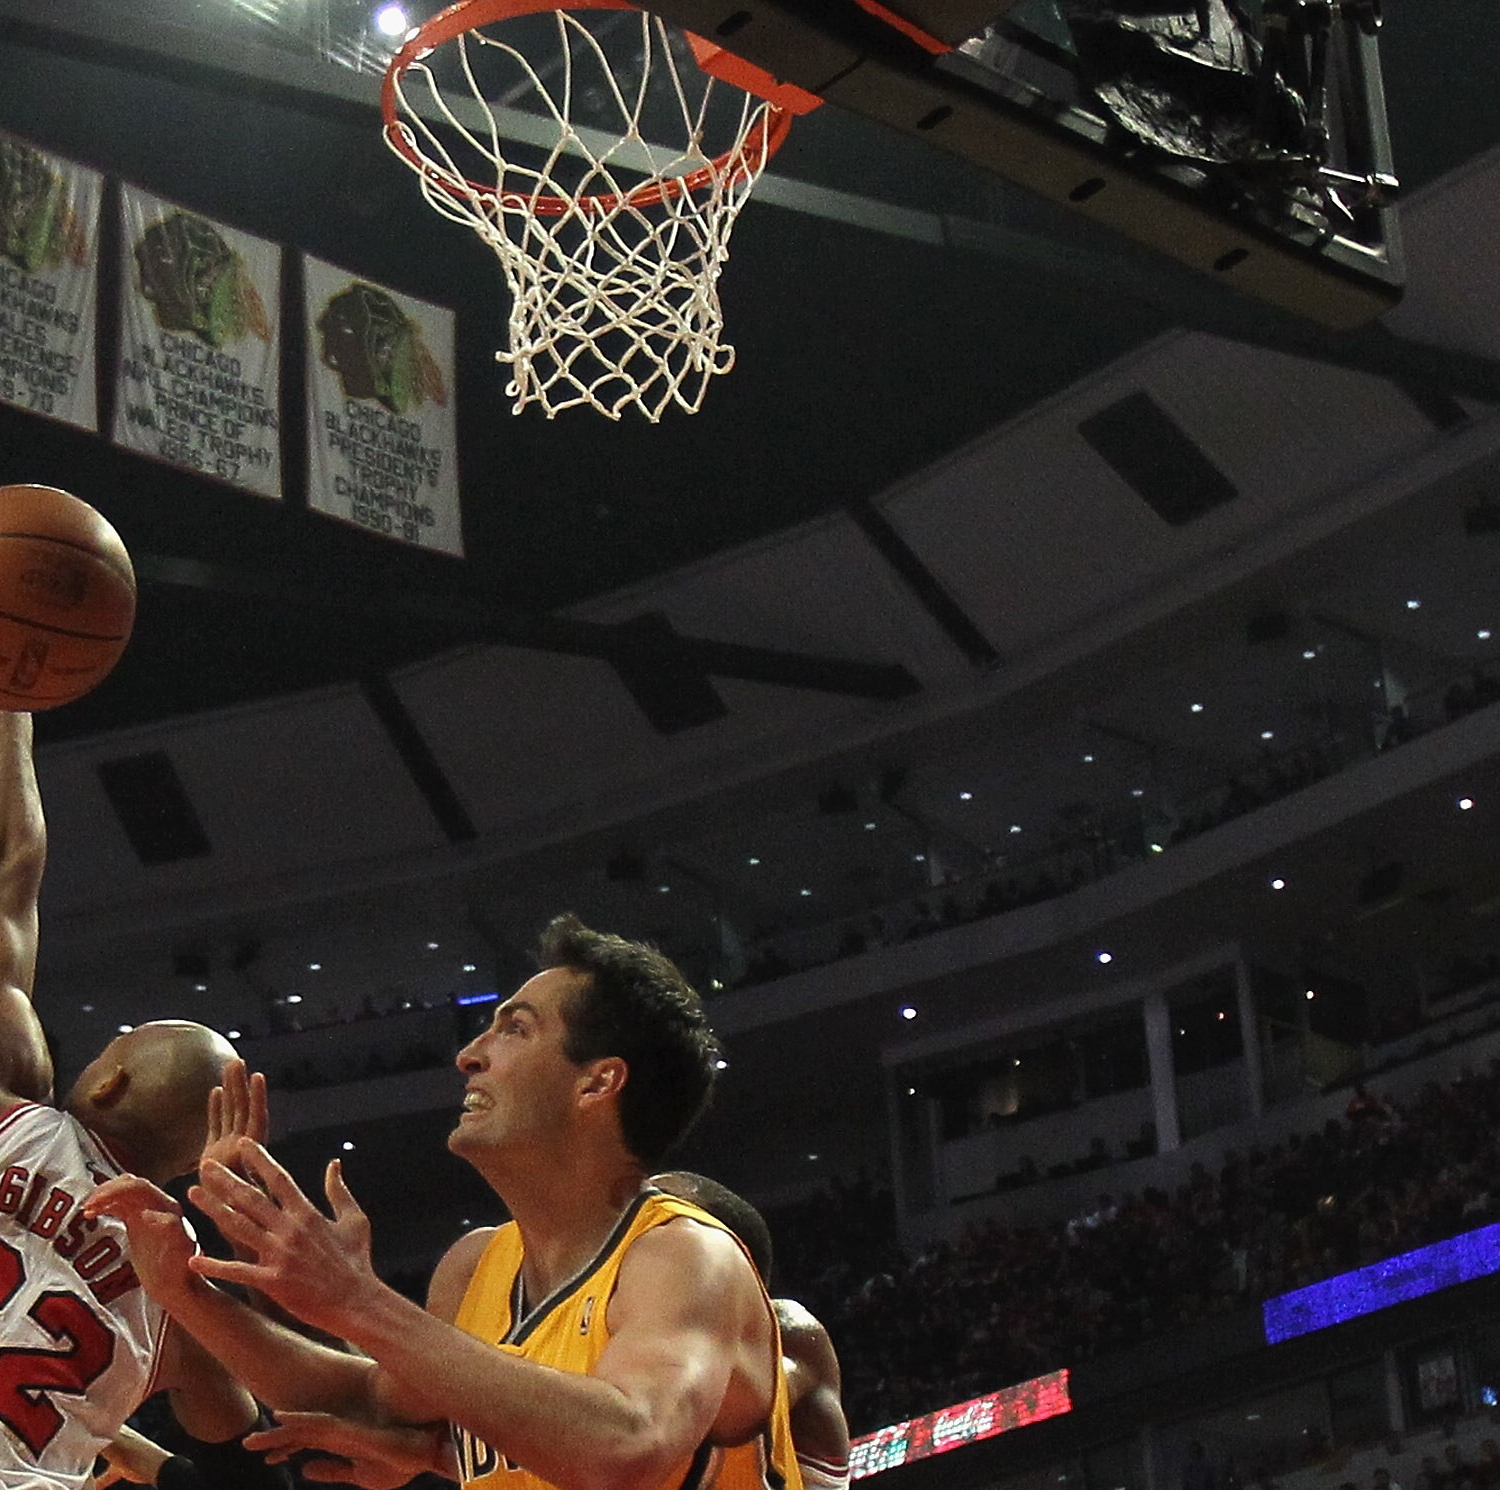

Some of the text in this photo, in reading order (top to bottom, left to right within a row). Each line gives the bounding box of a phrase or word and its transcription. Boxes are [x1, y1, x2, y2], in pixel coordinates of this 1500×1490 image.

[159, 331, 242, 379] CHICAGO
[324, 409, 441, 468] BLACKHAWKS
[346, 400, 422, 443] CHICAGO
[335, 475, 437, 528] CHAMPIONS
[349, 457, 420, 502] TROPHY
